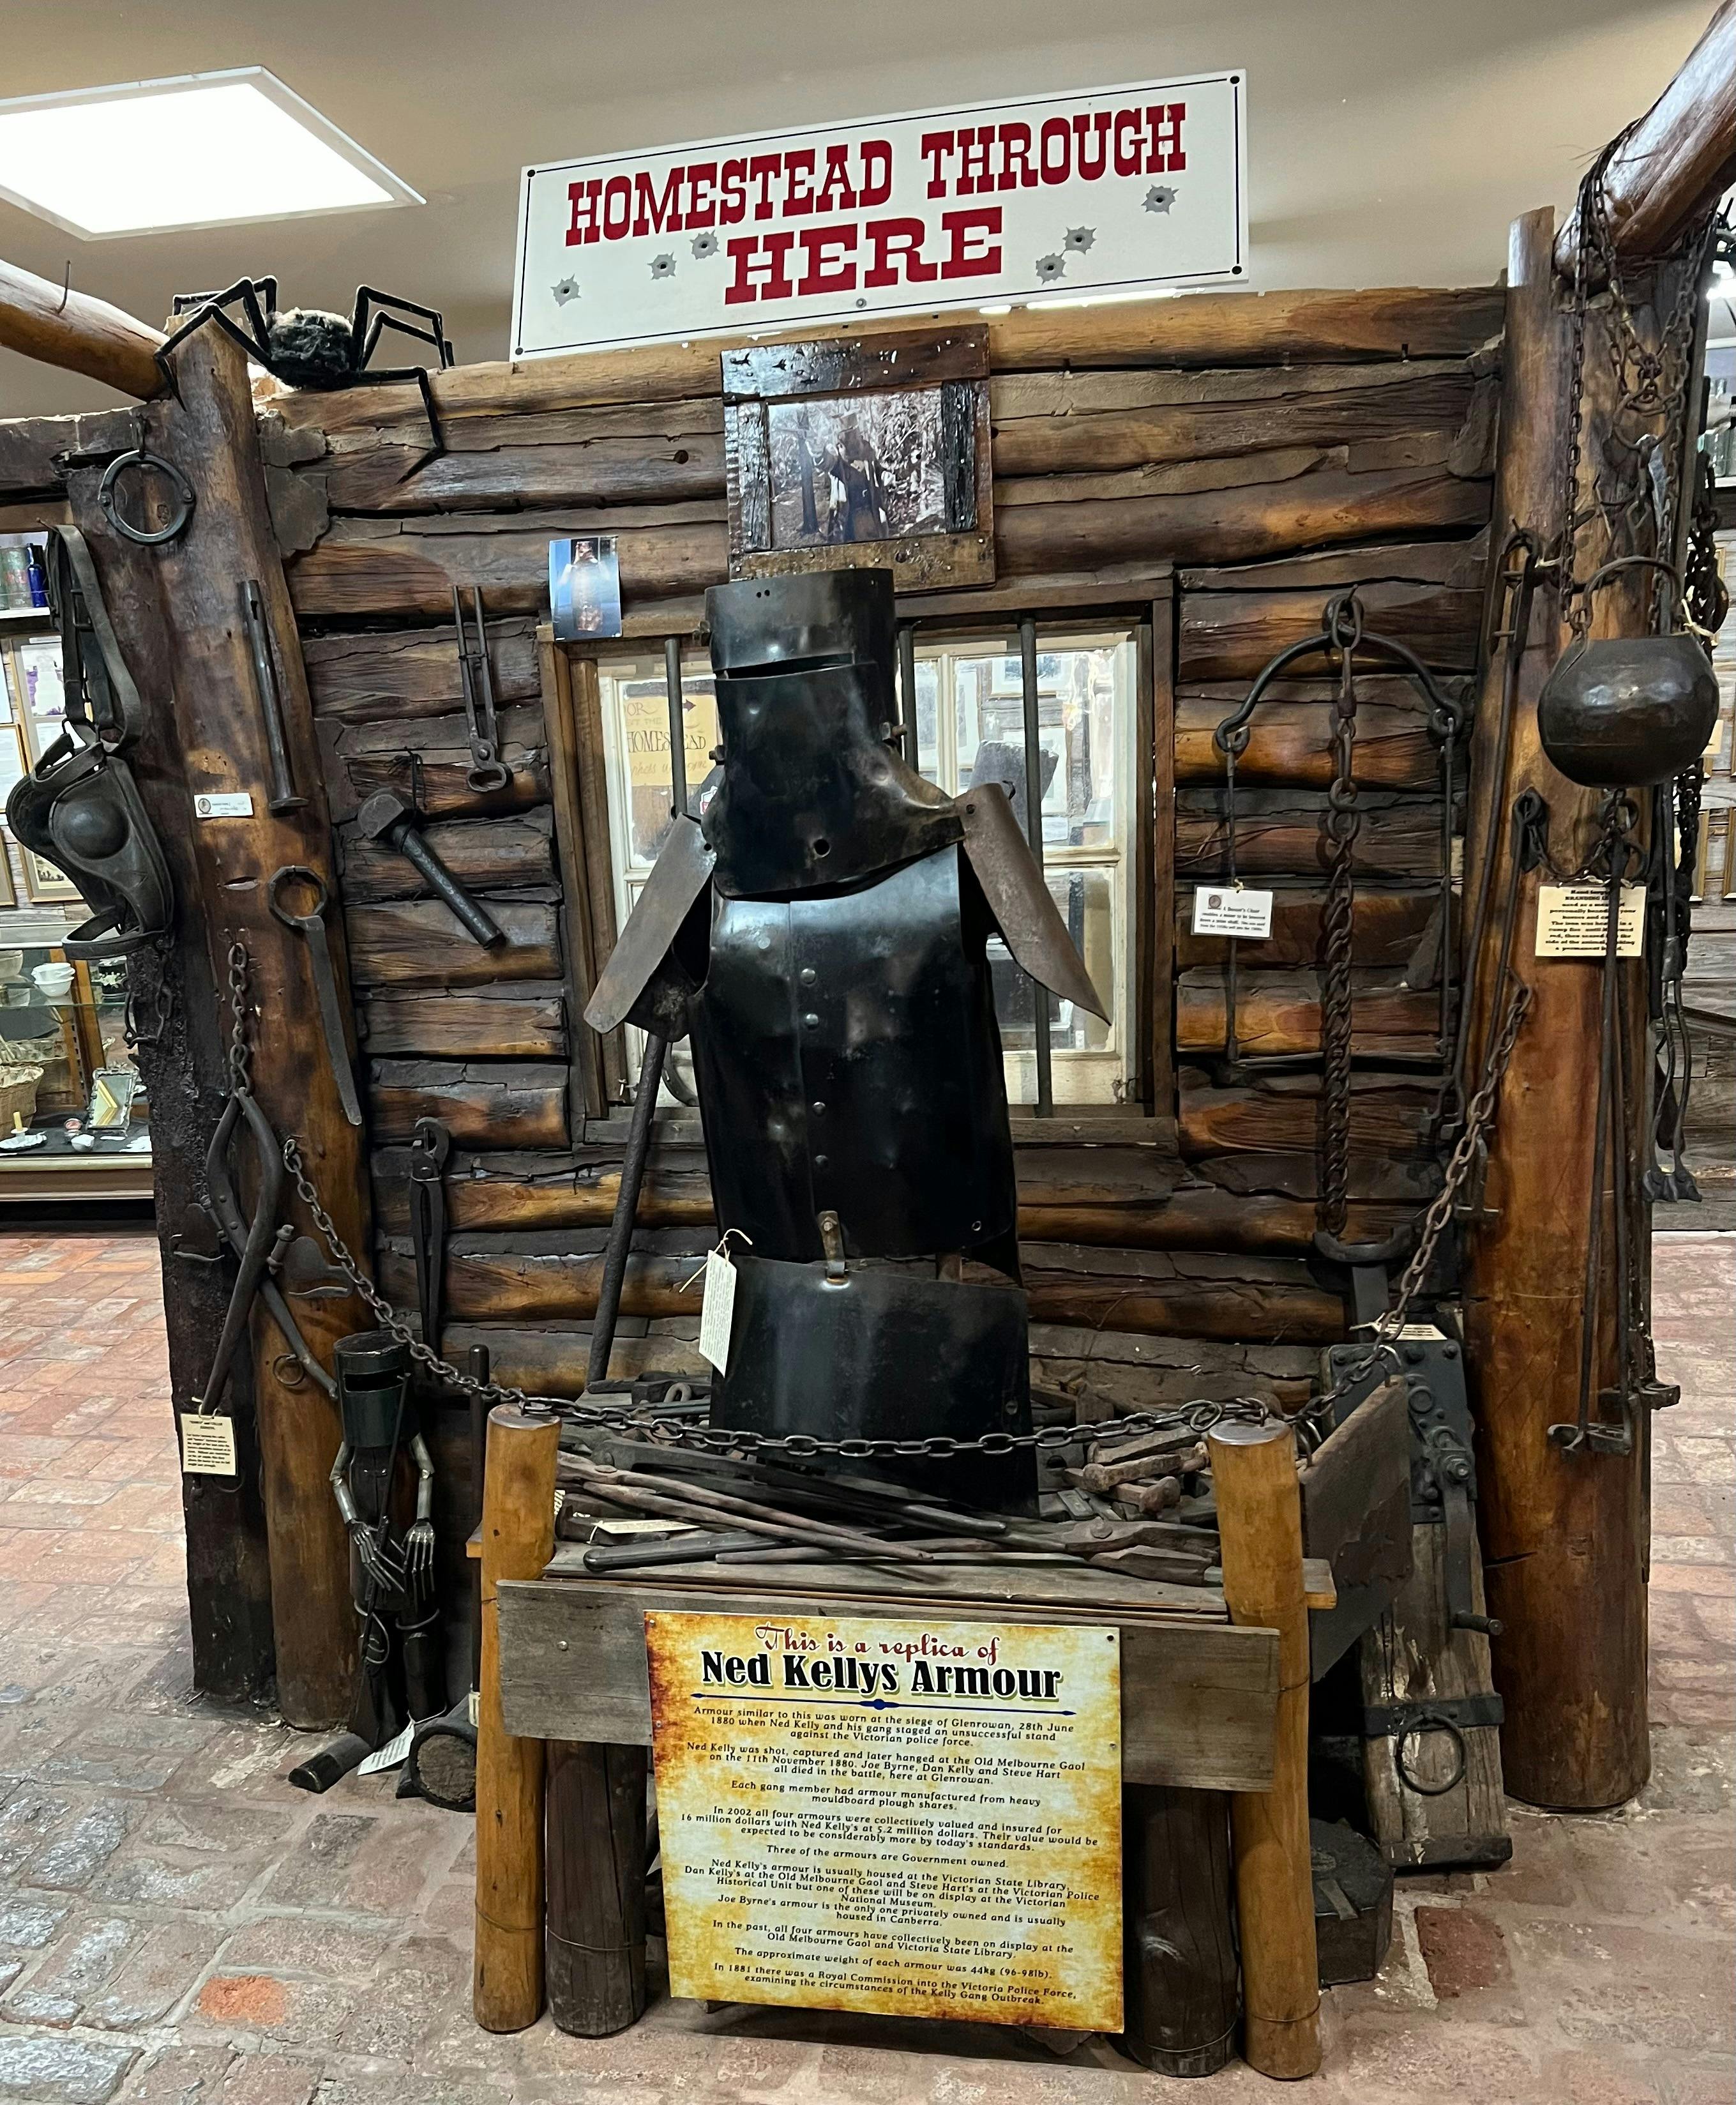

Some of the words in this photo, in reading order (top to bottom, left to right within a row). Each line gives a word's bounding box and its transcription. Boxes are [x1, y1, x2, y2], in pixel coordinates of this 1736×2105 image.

[566, 140, 891, 247] HOMESTEAD
[923, 104, 1185, 198] THROUGH
[725, 206, 1002, 305] HERE
[755, 1622, 820, 1651] This
[828, 1633, 847, 1652] is
[854, 1639, 872, 1653] a
[879, 1633, 969, 1663] replica
[977, 1636, 1000, 1665] of
[701, 1650, 769, 1685] Ned
[784, 1654, 897, 1694] Kellys
[911, 1660, 1061, 1699] Armour
[693, 1706, 733, 1715] Armour
[737, 1708, 774, 1717] similar
[792, 1710, 811, 1719] this
[885, 1715, 902, 1724] the
[905, 1716, 933, 1728] siege
[937, 1718, 948, 1728] of
[951, 1718, 1014, 1731] Glenrowan,
[1018, 1722, 1043, 1731] 28th
[1046, 1722, 1074, 1732] June
[711, 1716, 735, 1725] 1880
[738, 1717, 766, 1726] when
[769, 1719, 790, 1728] Ned
[794, 1719, 819, 1731] Kelly
[823, 1722, 843, 1730] and
[847, 1722, 862, 1731] his
[866, 1725, 892, 1735] gang
[896, 1726, 931, 1736] staged
[952, 1729, 1021, 1740] unsuccessful
[1025, 1733, 1055, 1741] stand
[790, 1729, 829, 1740] against
[833, 1731, 849, 1740] the
[853, 1731, 902, 1743] Victorian
[905, 1735, 939, 1745] police
[942, 1736, 973, 1747] force.
[687, 1742, 707, 1751] Ned
[710, 1743, 736, 1754] Kelly
[763, 1745, 789, 1756] shot,
[792, 1749, 840, 1759] captured
[843, 1751, 863, 1759] and
[866, 1751, 892, 1761] later
[896, 1752, 935, 1765] hanged
[953, 1756, 970, 1765] the
[974, 1756, 993, 1766] Old
[997, 1758, 1055, 1769] Melbourne
[1059, 1761, 1085, 1771] Gaol
[725, 1752, 742, 1761] the
[746, 1754, 768, 1763] 11th
[771, 1755, 826, 1766] November
[830, 1759, 857, 1768] 1880.
[861, 1759, 880, 1769] Joe
[883, 1761, 918, 1773] Byrne,
[922, 1763, 944, 1772] Dan
[947, 1765, 974, 1776] Kelly
[977, 1767, 998, 1775] and
[1002, 1767, 1032, 1777] Steve
[1036, 1769, 1060, 1779] Hart
[774, 1765, 787, 1773] all
[791, 1765, 813, 1774] died
[817, 1767, 827, 1775] in
[831, 1767, 847, 1777] the
[851, 1768, 885, 1780] battle,
[889, 1770, 912, 1780] here
[931, 1773, 993, 1784] Glenrowan.
[731, 1780, 756, 1790] Each
[760, 1784, 785, 1793] gang
[789, 1784, 831, 1793] member
[834, 1786, 854, 1795] had
[857, 1789, 897, 1797] armour
[900, 1791, 976, 1802] manufactured
[979, 1794, 1005, 1804] from
[1009, 1795, 1041, 1807] heavy
[811, 1795, 875, 1805] mouldboard
[879, 1798, 914, 1809] plough
[919, 1800, 957, 1810] shares.
[767, 1844, 796, 1854] Three
[799, 1847, 810, 1857] of
[813, 1848, 829, 1857] the
[833, 1851, 877, 1860] armours
[902, 1853, 967, 1866] Government
[970, 1859, 1008, 1867] owned.
[735, 1947, 753, 1956] The
[757, 1950, 820, 1961] approximate
[824, 1954, 859, 1965] weight
[862, 1957, 873, 1966] of
[876, 1959, 900, 1967] each
[903, 1962, 943, 1970] armour
[970, 1966, 995, 1976] 44kg
[1000, 1966, 1052, 1979] (96-98lb).
[714, 1962, 724, 1971] In
[728, 1964, 750, 1973] 1881
[755, 1966, 781, 1975] there
[818, 1970, 847, 1981] Royal
[850, 1973, 913, 1986] Commission
[917, 1978, 937, 1987] into
[941, 1980, 958, 1989] the
[960, 1982, 1003, 1993] Victoria
[1007, 1985, 1039, 1995] Police
[1043, 1987, 1076, 1999] Force,
[744, 1975, 796, 1987] examining
[800, 1978, 816, 1987] the
[819, 1980, 893, 1993] circumstances
[896, 1986, 907, 1995] of
[910, 1987, 927, 1996] the
[930, 1987, 956, 1999] Kelly
[960, 1990, 987, 2002] Gang
[991, 1993, 1044, 2005] Outbreak.
